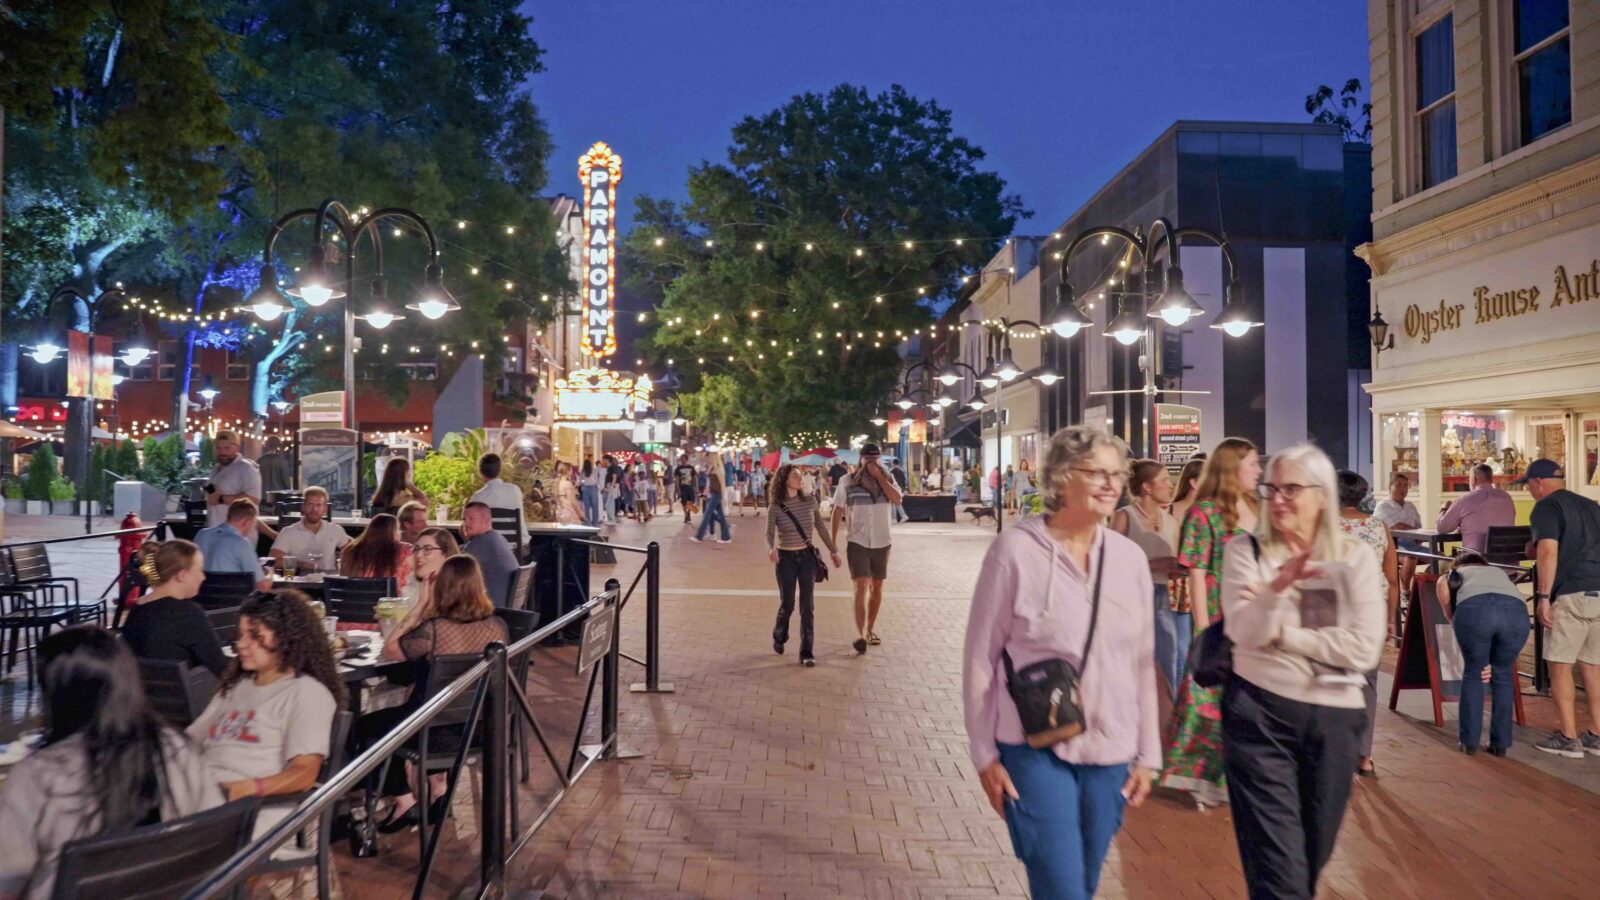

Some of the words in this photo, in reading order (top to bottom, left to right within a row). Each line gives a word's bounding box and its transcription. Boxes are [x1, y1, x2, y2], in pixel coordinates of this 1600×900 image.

[589, 171, 609, 346] PARAMOUNT
[1404, 299, 1465, 344] Oyster
[1473, 285, 1540, 324] House
